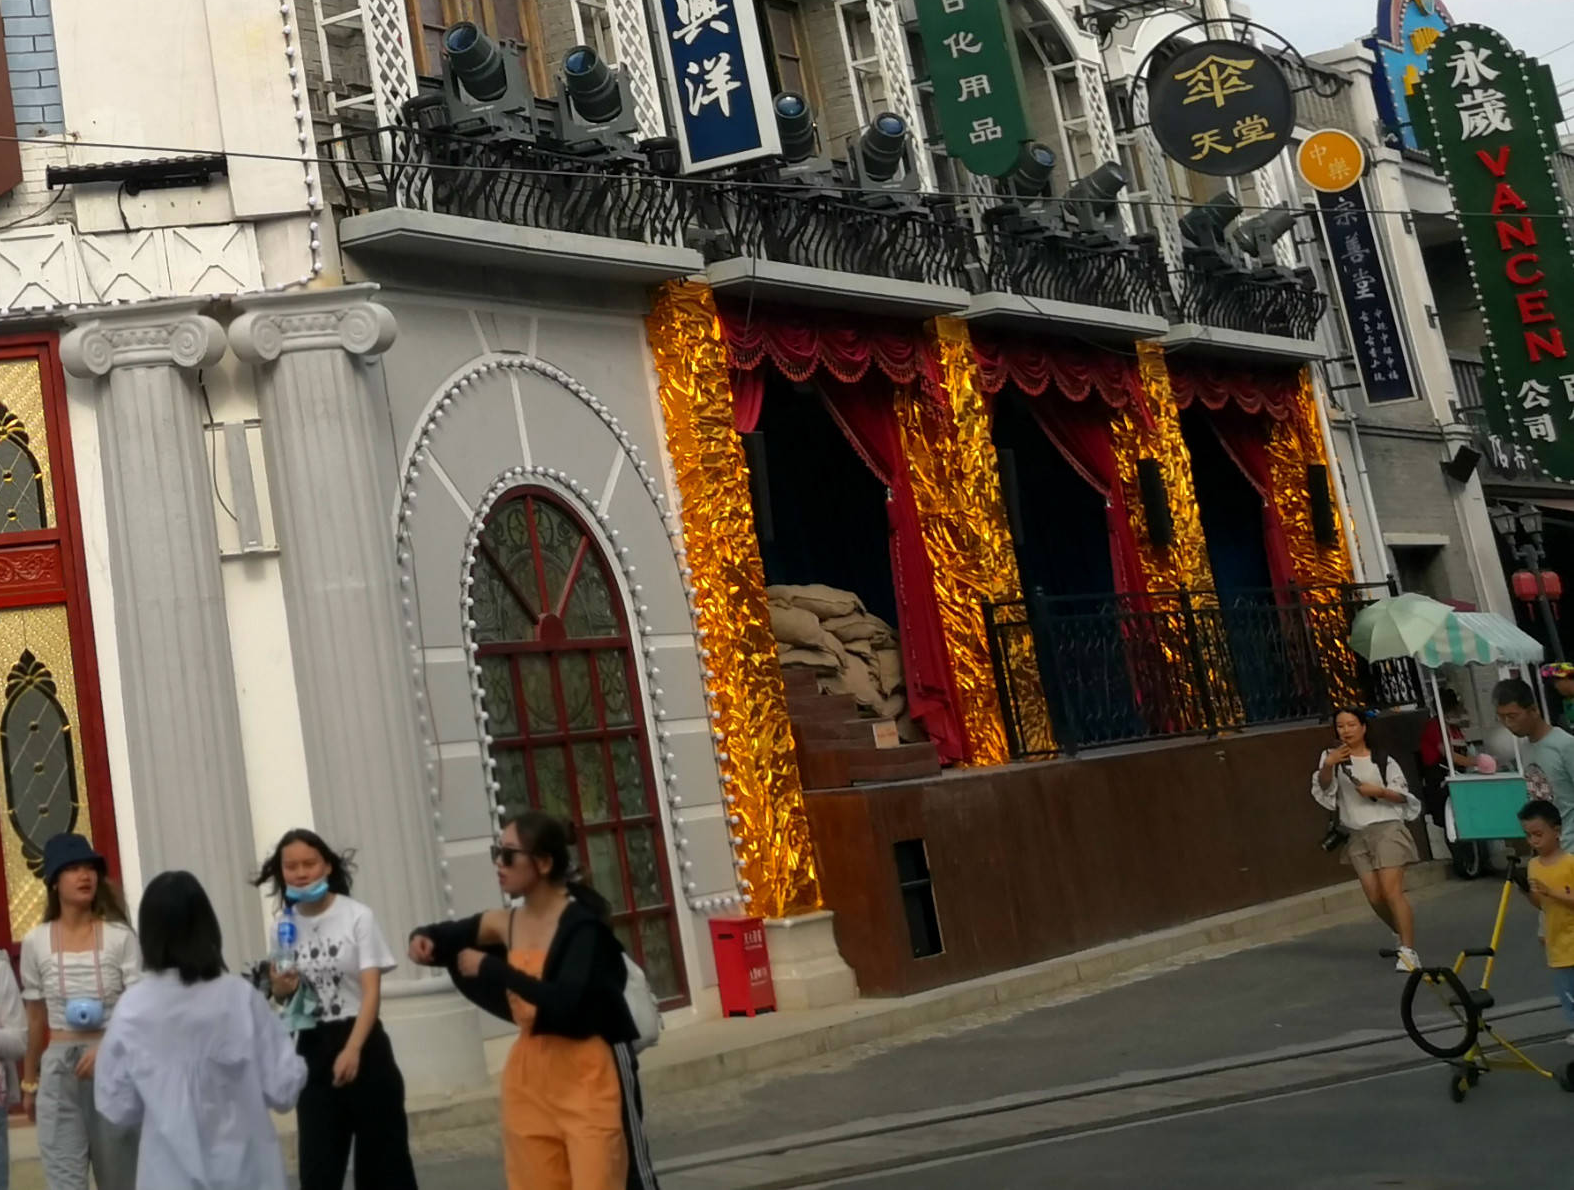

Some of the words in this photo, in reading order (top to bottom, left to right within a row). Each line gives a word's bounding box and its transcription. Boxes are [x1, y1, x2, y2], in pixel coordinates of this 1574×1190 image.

[1174, 55, 1256, 108] 傘
[1190, 114, 1276, 160] 天堂
[1476, 145, 1568, 363] VANCEN
[1517, 379, 1557, 442] 公司
